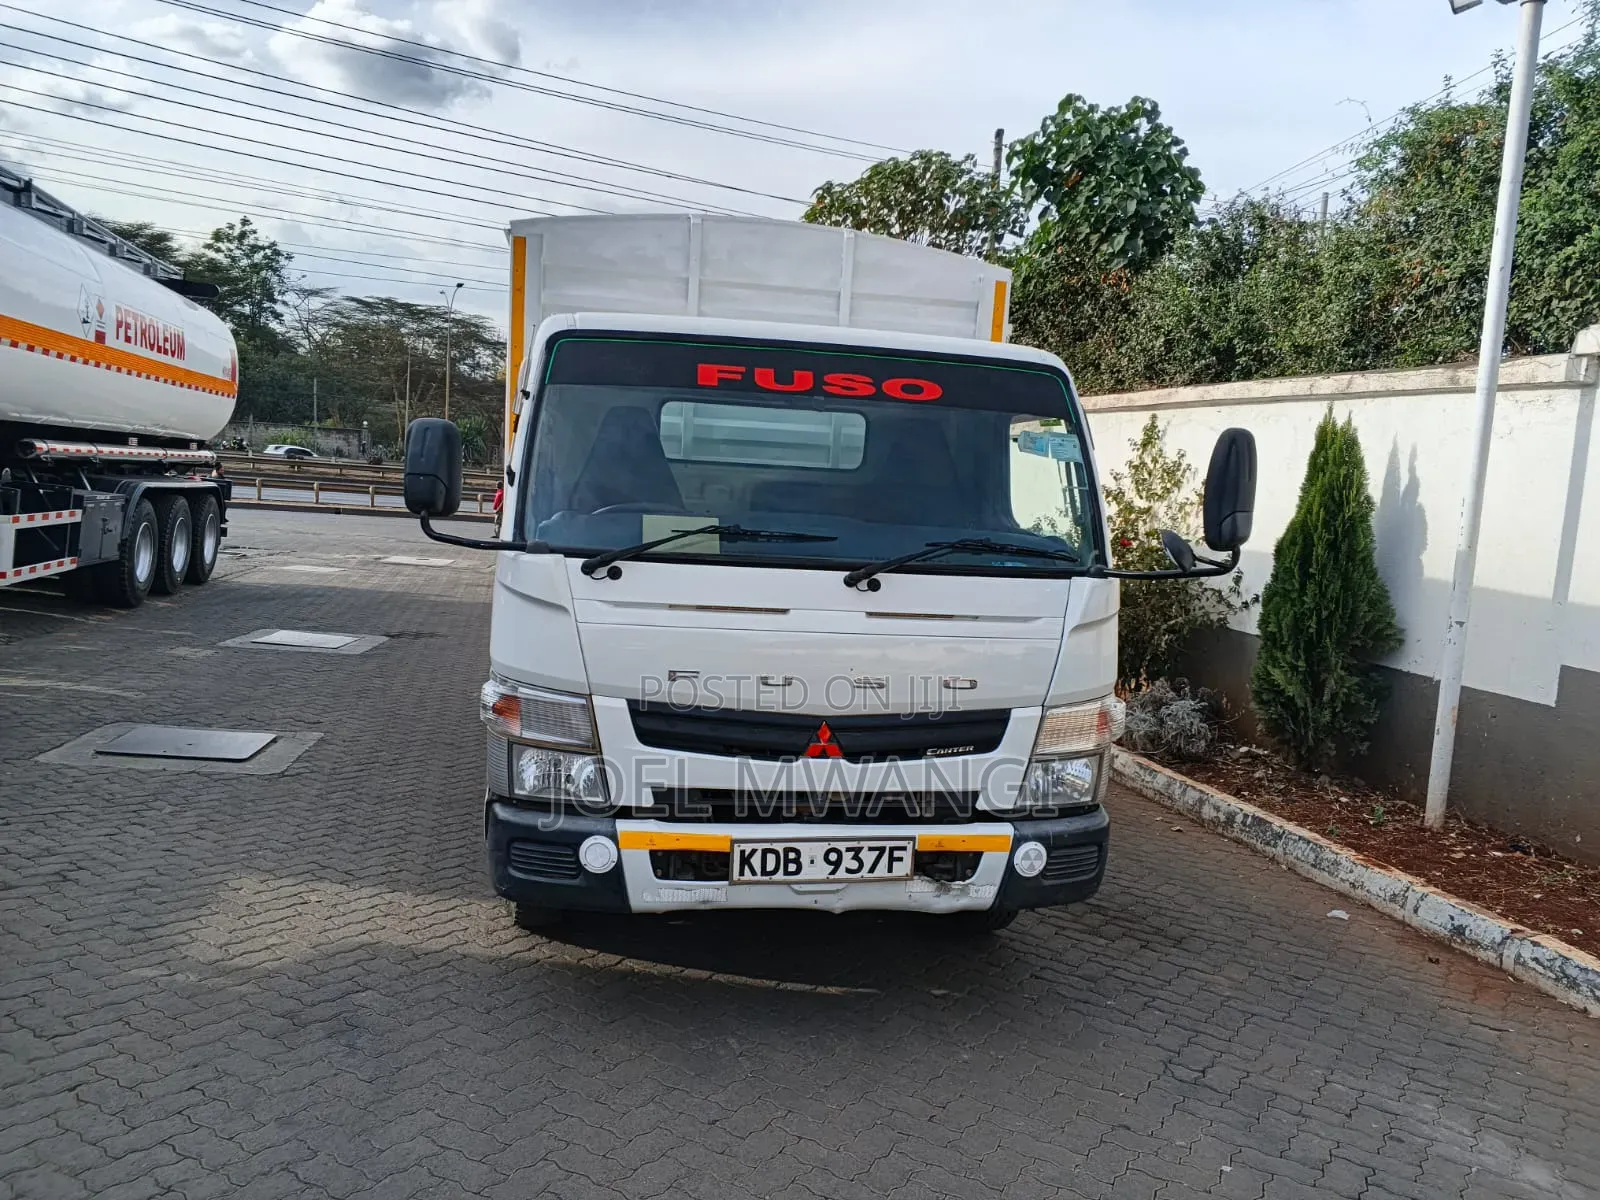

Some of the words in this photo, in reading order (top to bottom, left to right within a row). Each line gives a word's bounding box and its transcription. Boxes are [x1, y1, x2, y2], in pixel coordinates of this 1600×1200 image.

[115, 304, 186, 361] PETROLEUM
[697, 363, 943, 401] FUSO
[738, 847, 803, 877] KDB
[823, 845, 908, 876] 937F
